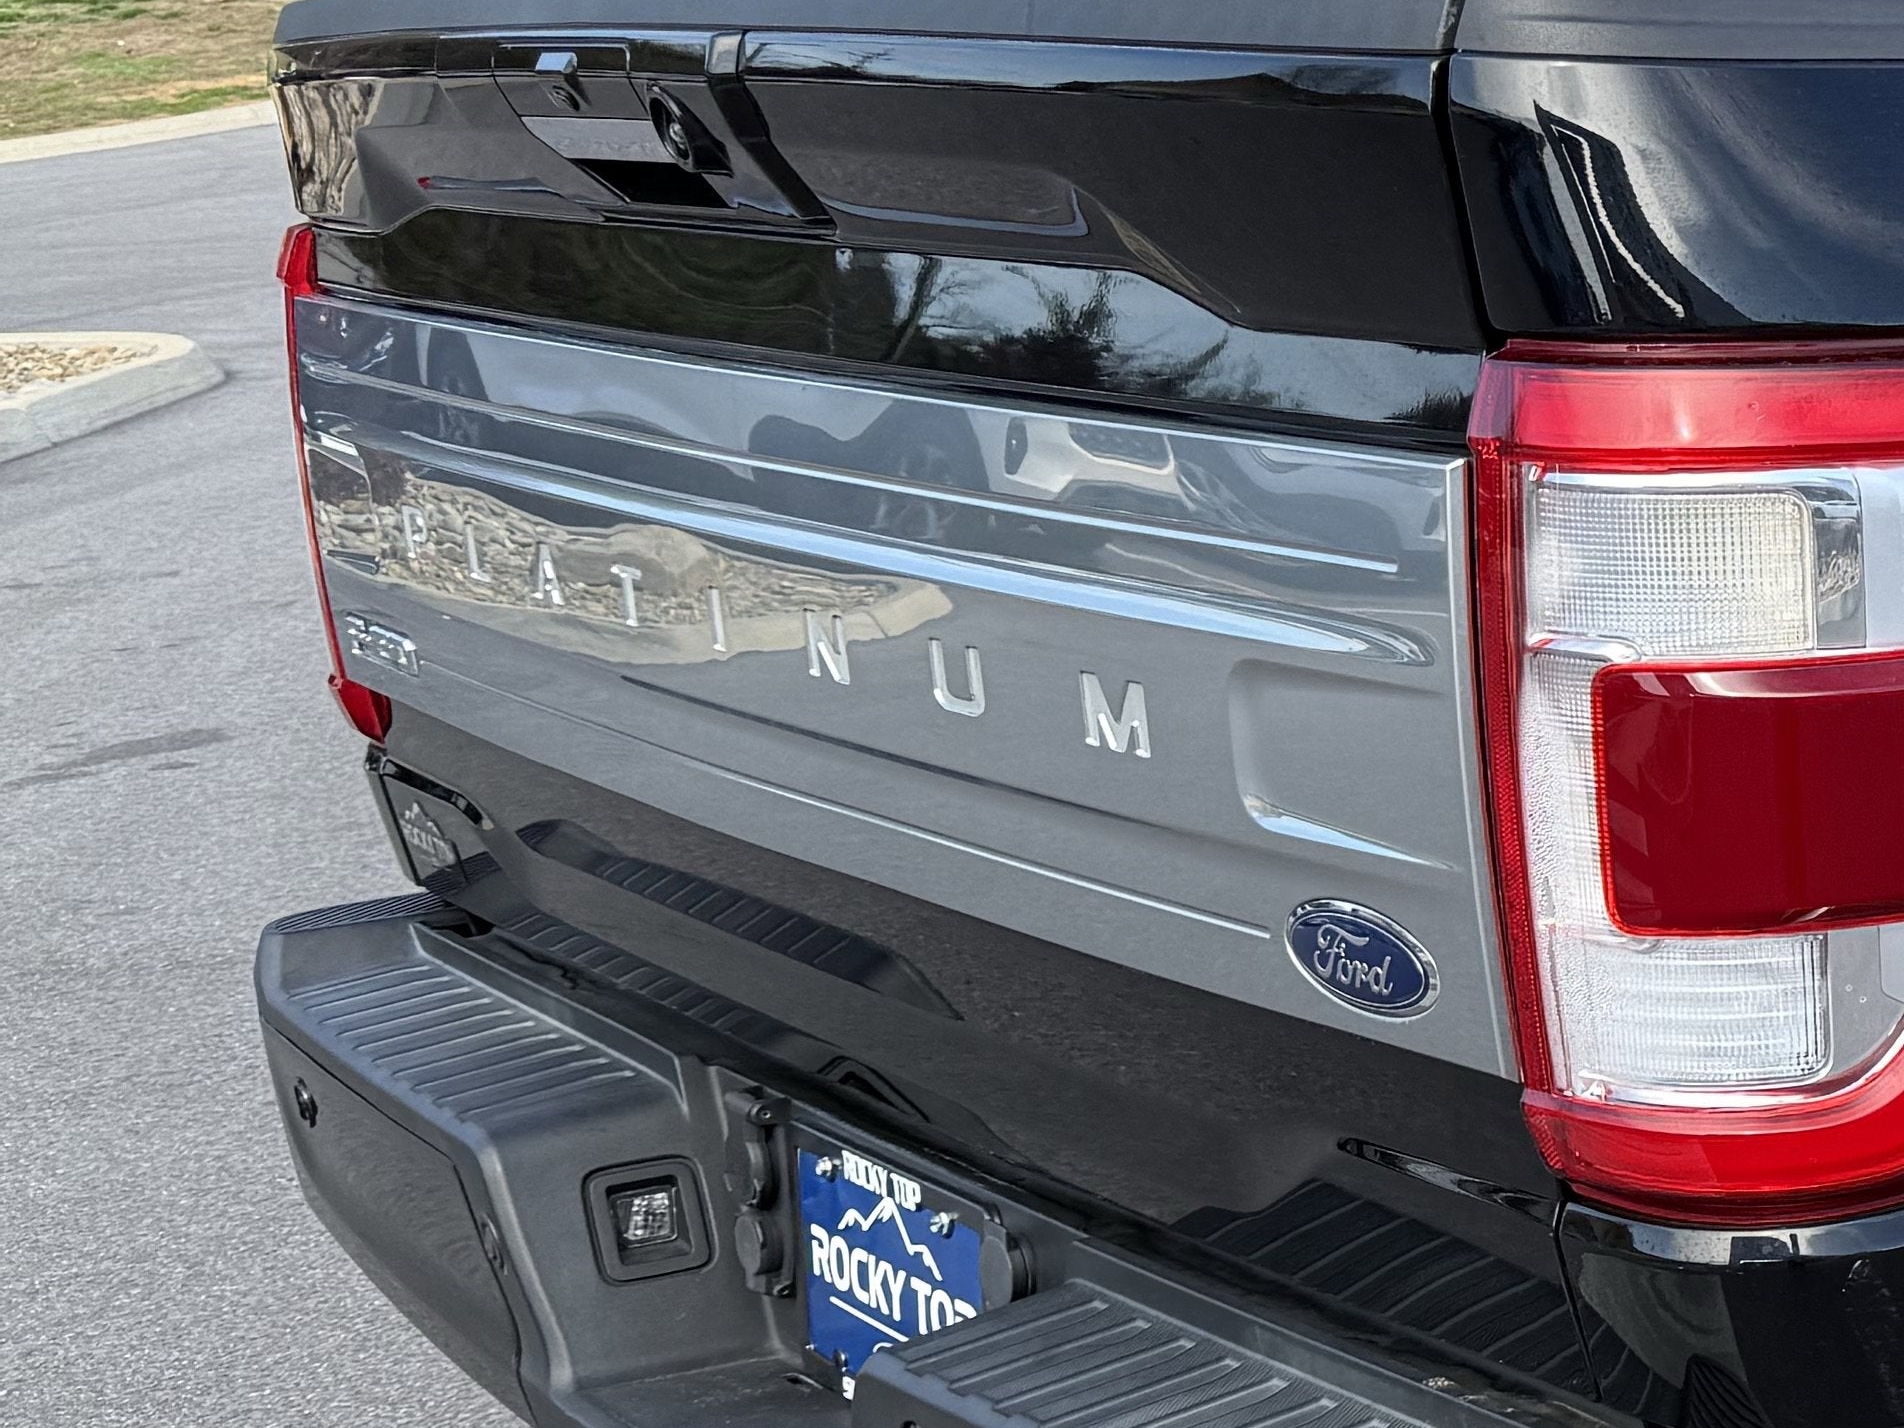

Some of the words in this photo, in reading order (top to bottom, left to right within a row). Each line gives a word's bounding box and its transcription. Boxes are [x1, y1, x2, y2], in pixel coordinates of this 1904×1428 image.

[400, 504, 1152, 759] PLATINUM
[1313, 923, 1393, 996] Ford
[842, 1150, 888, 1198] ROCKY
[890, 1172, 922, 1212] TOP
[810, 1223, 906, 1322] ROCKY
